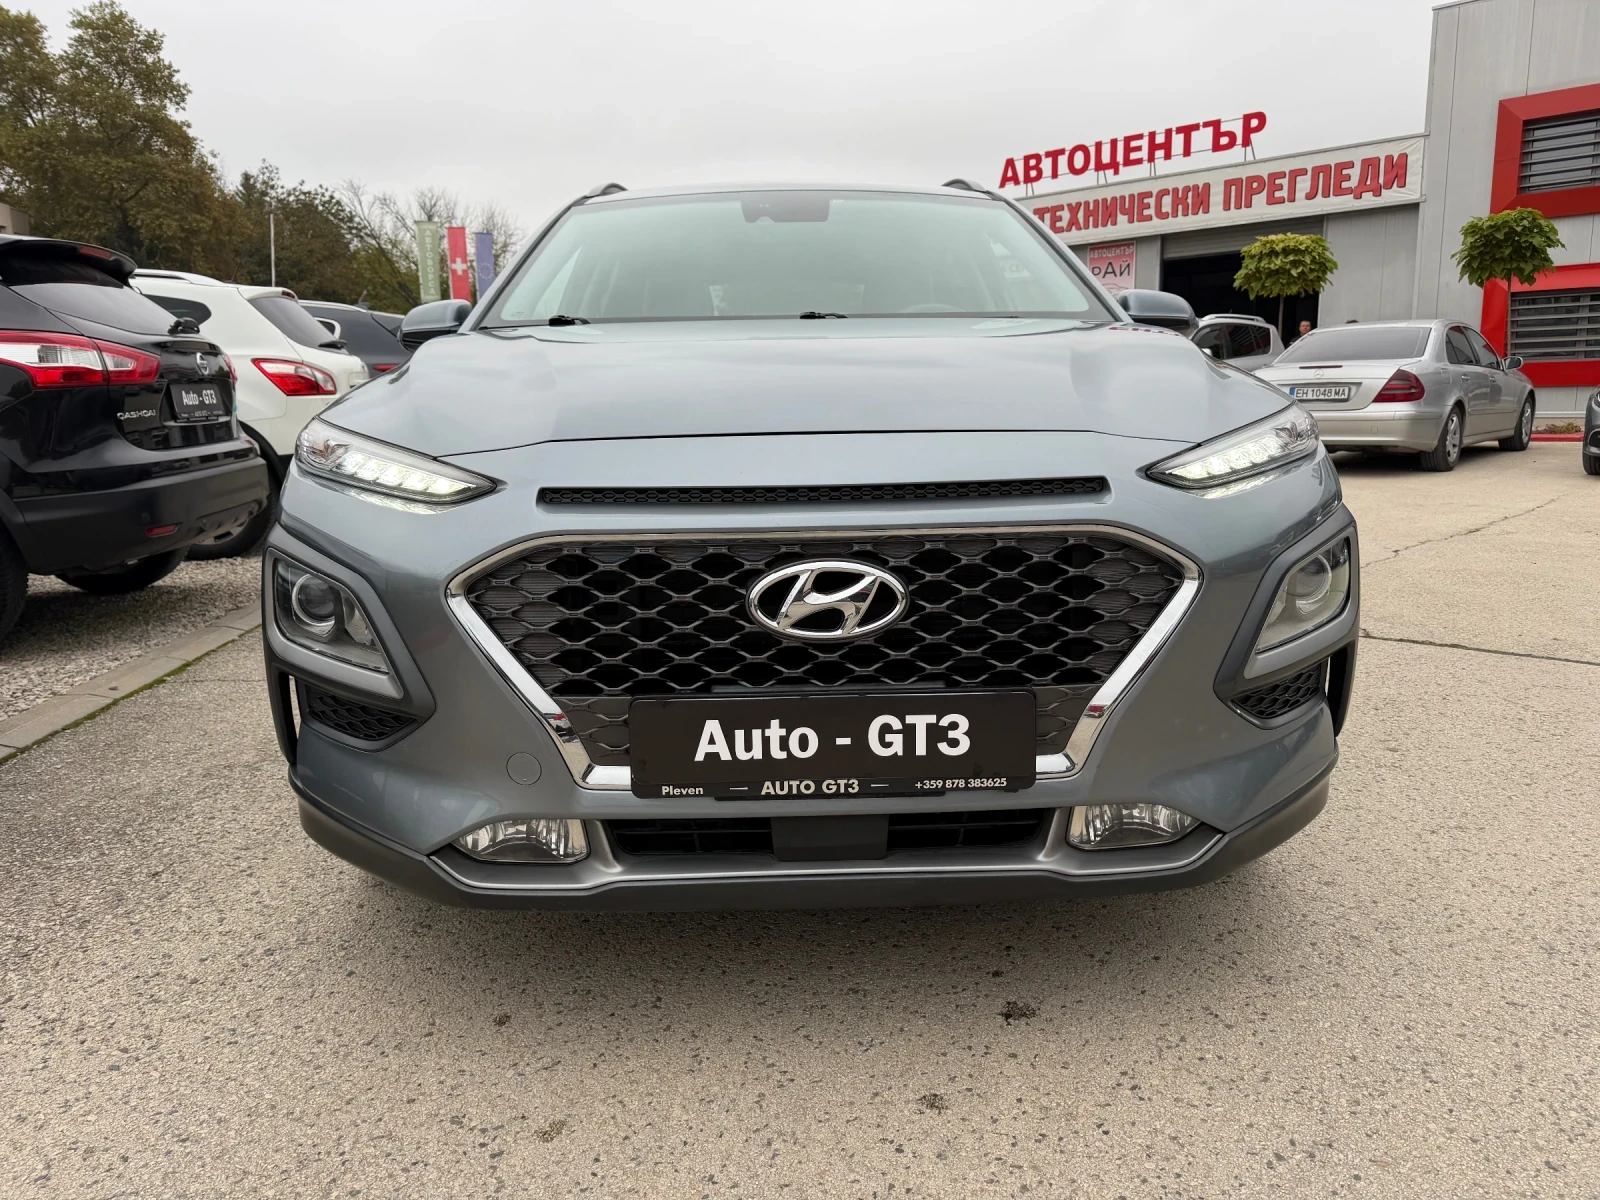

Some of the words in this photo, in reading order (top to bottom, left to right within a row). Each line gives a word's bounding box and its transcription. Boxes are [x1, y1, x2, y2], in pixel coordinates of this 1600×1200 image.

[999, 111, 1267, 189] АВТОЦЕНТЪР
[1033, 182, 1211, 234] ТЕХНИЧЕСКИ
[1223, 153, 1408, 211] ПРЕГЛЕДИ
[1090, 245, 1134, 259] АВТОЦЕНТЪР
[182, 390, 199, 405] Auto
[203, 389, 217, 405] GT3
[1311, 388, 1333, 398] 1048
[117, 409, 156, 420] QASHQAI
[694, 719, 819, 762] Auto
[867, 714, 971, 757] GT3
[661, 785, 704, 796] Pleven
[760, 780, 816, 796] AUTO
[821, 779, 860, 794] GT3
[915, 780, 943, 790] +359
[945, 779, 966, 789] 878
[967, 778, 1008, 788] 383625
